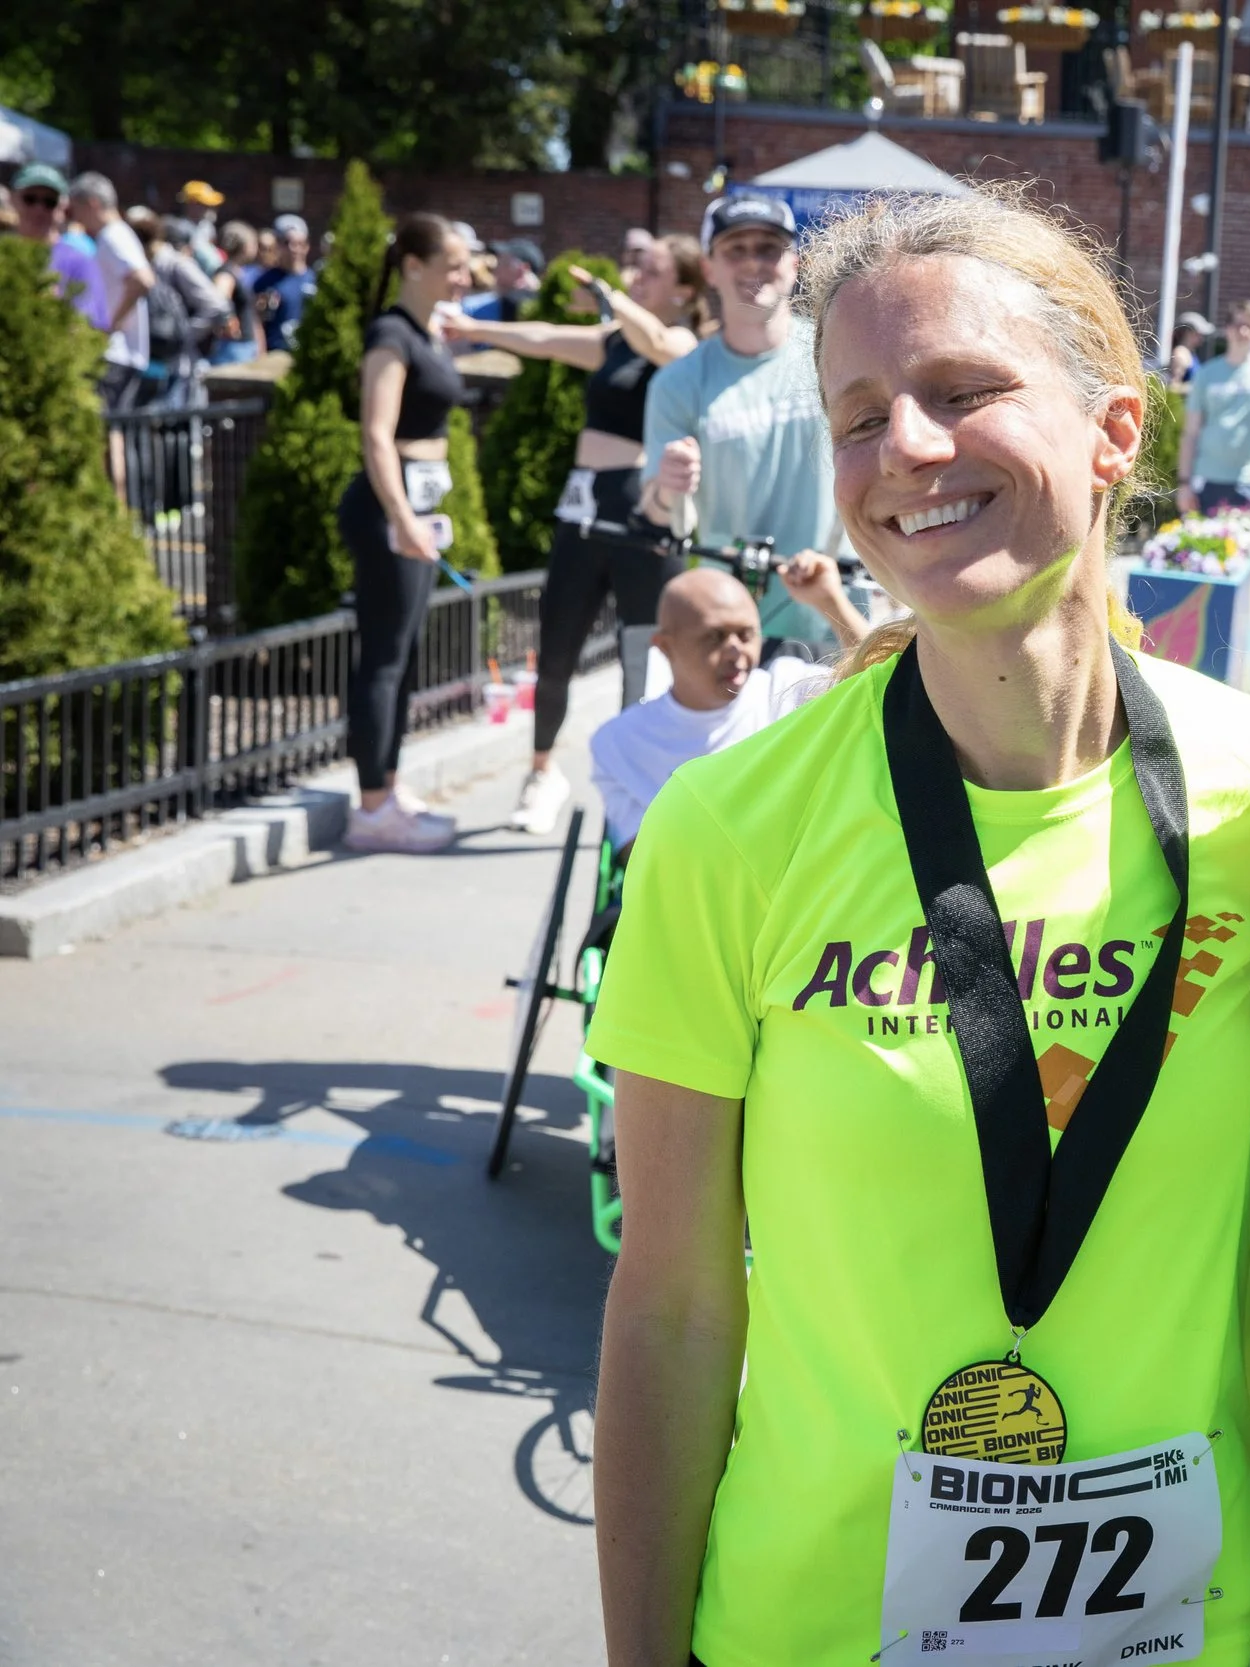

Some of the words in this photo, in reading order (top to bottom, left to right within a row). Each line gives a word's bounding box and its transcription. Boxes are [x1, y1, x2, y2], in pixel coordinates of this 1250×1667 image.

[793, 918, 1135, 1010] Achles
[931, 1384, 1000, 1408] ONIC
[926, 1402, 999, 1427] ONIC
[926, 1420, 998, 1444] ONIC
[983, 1426, 1064, 1452] BIONIC
[930, 1456, 1153, 1504] BIONIC
[929, 1502, 991, 1515] CAMBRIDGE
[1015, 1507, 1043, 1515] 2026
[959, 1515, 1154, 1622] 272
[1120, 1633, 1185, 1660] DRINK
